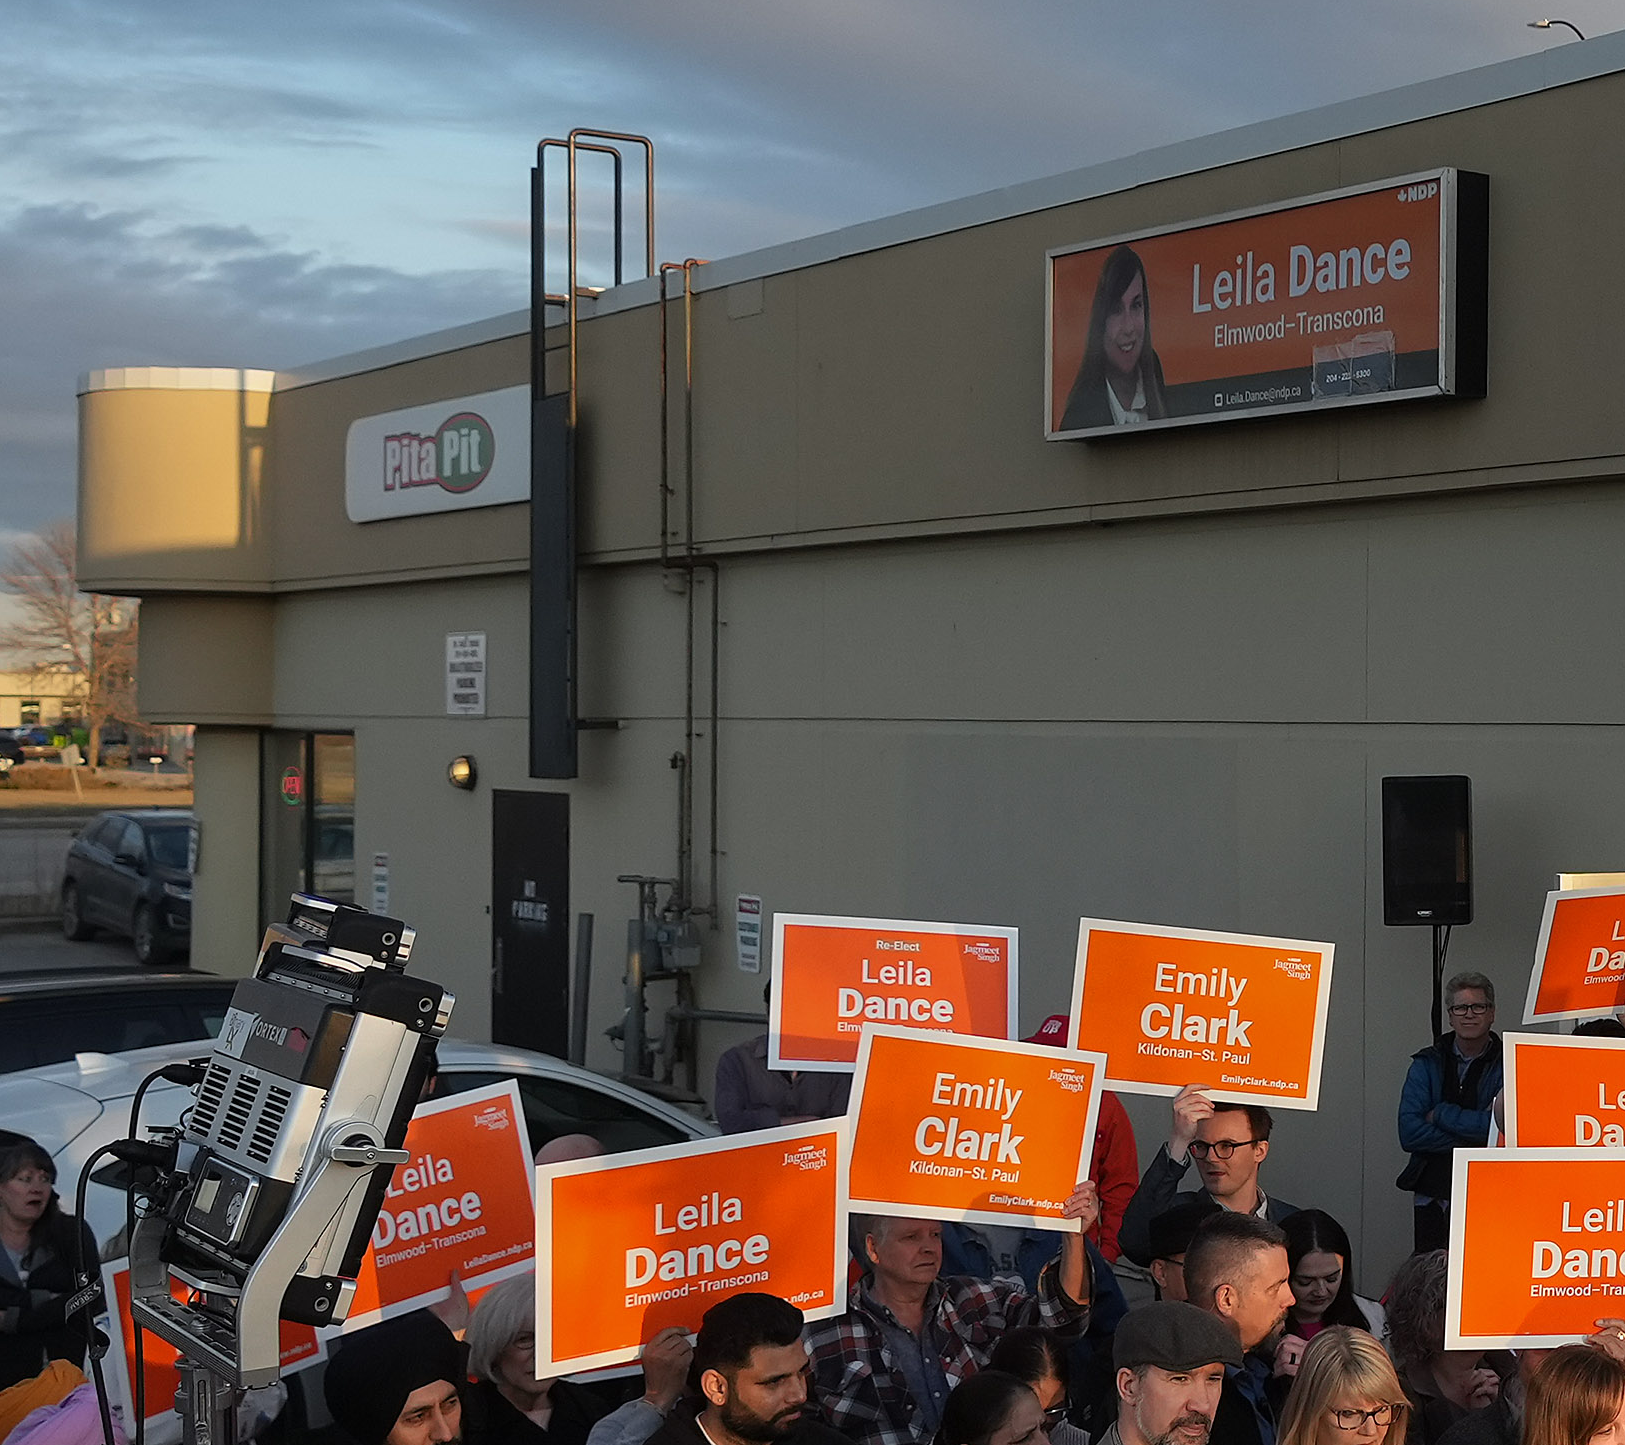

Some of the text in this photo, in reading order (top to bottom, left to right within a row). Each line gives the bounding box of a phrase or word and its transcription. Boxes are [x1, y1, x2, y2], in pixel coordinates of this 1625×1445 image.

[1402, 177, 1443, 203] NDP
[1192, 238, 1411, 314] Leila Dance
[384, 428, 482, 491] Pita Pit
[875, 939, 920, 952] Re-Elect
[862, 959, 932, 987] Leila
[1273, 960, 1312, 974] Jagmeet
[1286, 968, 1312, 982] Singh
[1154, 962, 1248, 1013] Emily
[838, 987, 954, 1023] Dance
[1140, 1002, 1253, 1048] Clark
[1221, 1050, 1251, 1065] Paul
[1047, 1069, 1085, 1084] Jagmeet
[1060, 1080, 1084, 1094] Singh
[1220, 1074, 1299, 1090] EmilyClark.ndp.ca
[931, 1072, 1023, 1121] Emily
[914, 1116, 1025, 1165] Clark
[782, 1147, 827, 1168] Jagmeet
[800, 1158, 827, 1171] Singh
[384, 1157, 454, 1198] Leila
[991, 1168, 1020, 1184] Paul
[655, 1192, 742, 1236] Leila
[988, 1193, 1067, 1215] EmilyClark.ndp.ca
[371, 1191, 482, 1250] Dance
[625, 1234, 770, 1289] Dance
